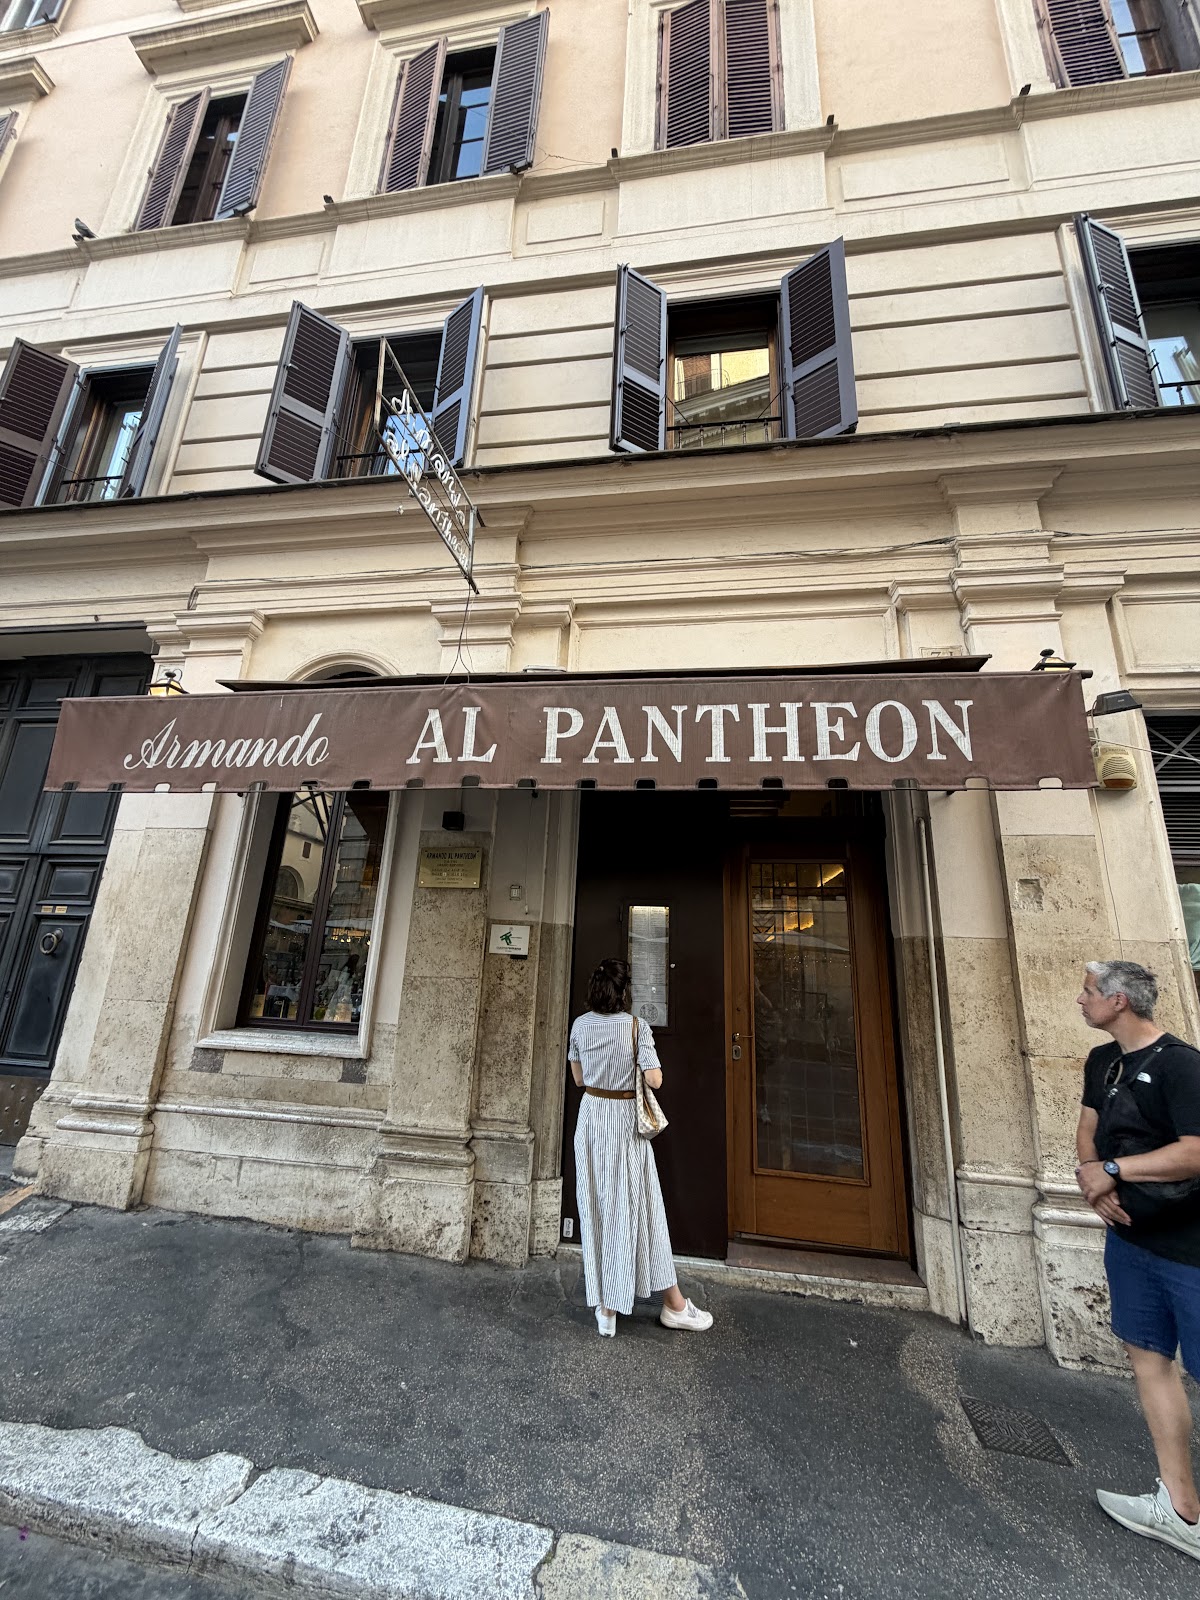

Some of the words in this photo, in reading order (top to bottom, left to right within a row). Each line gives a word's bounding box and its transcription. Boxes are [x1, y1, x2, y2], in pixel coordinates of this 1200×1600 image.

[123, 712, 330, 769] Armando
[406, 706, 499, 765] AL
[540, 699, 975, 764] PANTHEON
